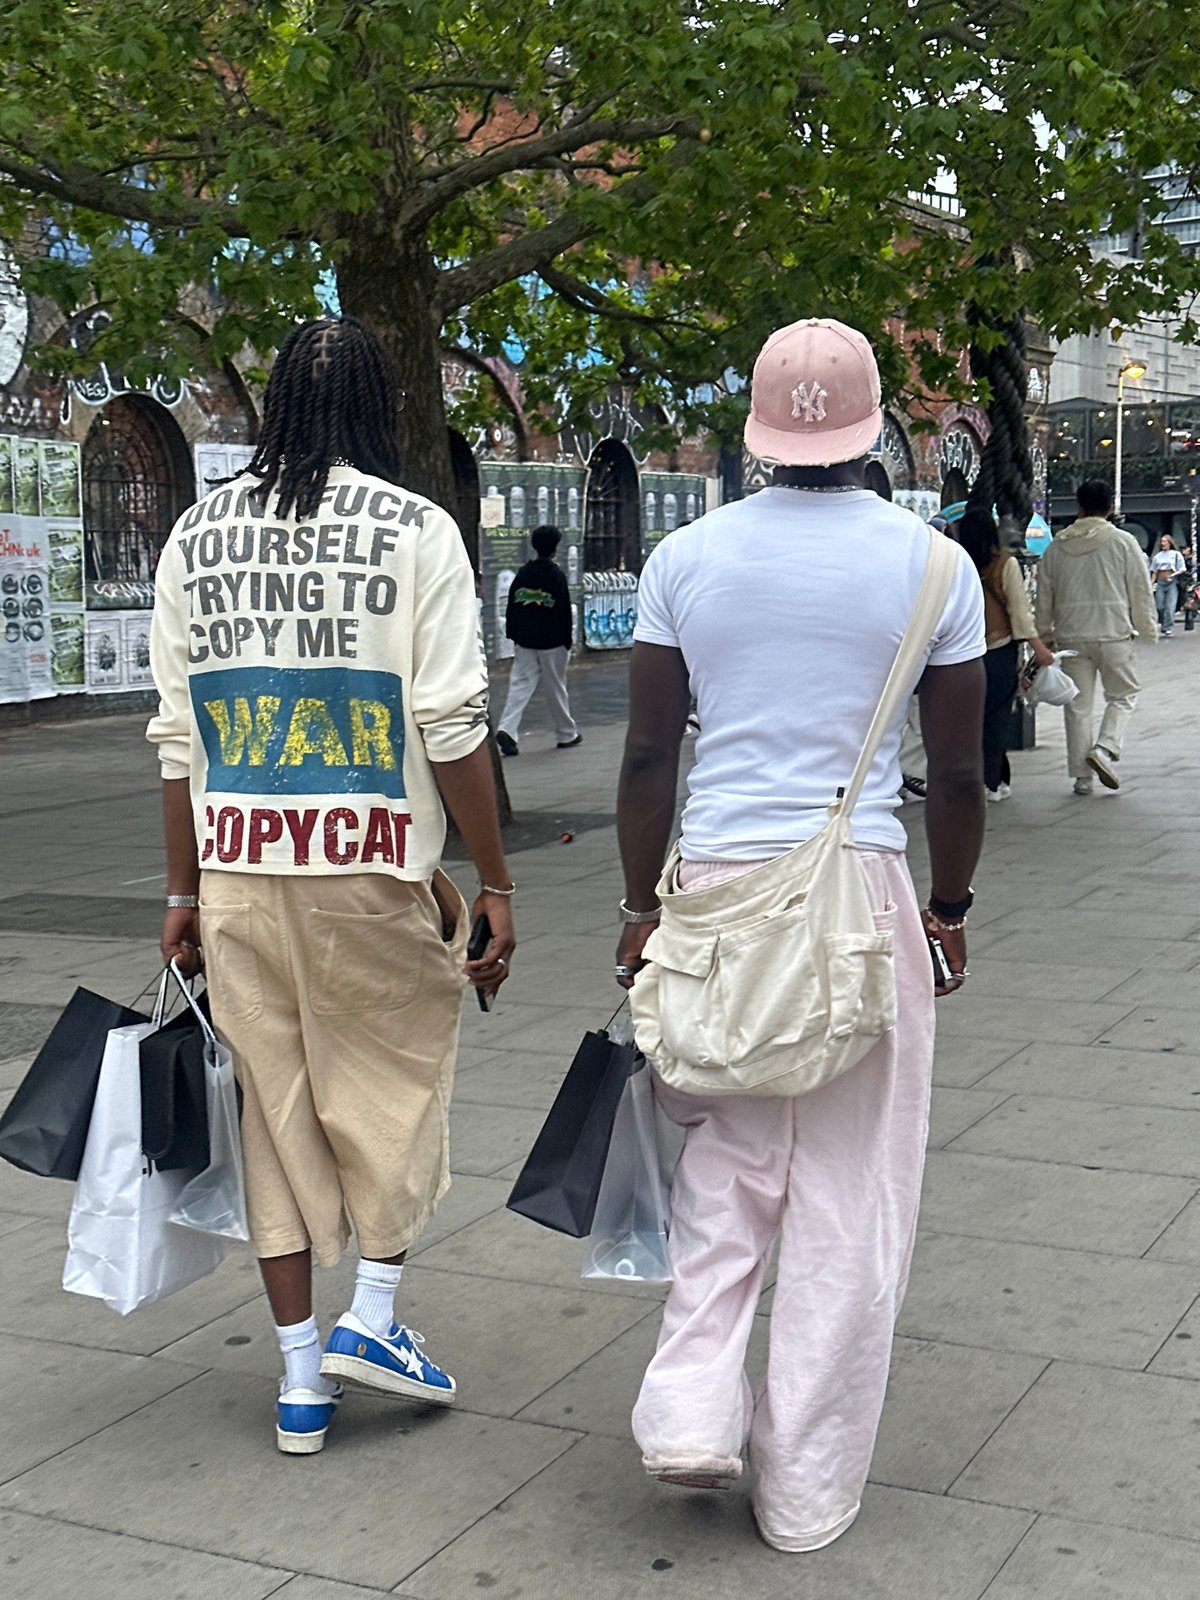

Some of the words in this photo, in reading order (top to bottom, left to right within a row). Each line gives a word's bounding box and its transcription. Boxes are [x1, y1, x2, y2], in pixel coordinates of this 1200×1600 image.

[178, 524, 399, 574] YOURSELF
[183, 571, 324, 617] TRYING
[338, 571, 398, 616] TO
[188, 617, 285, 663] COPY
[297, 617, 359, 659] ME
[203, 695, 397, 771] WAR
